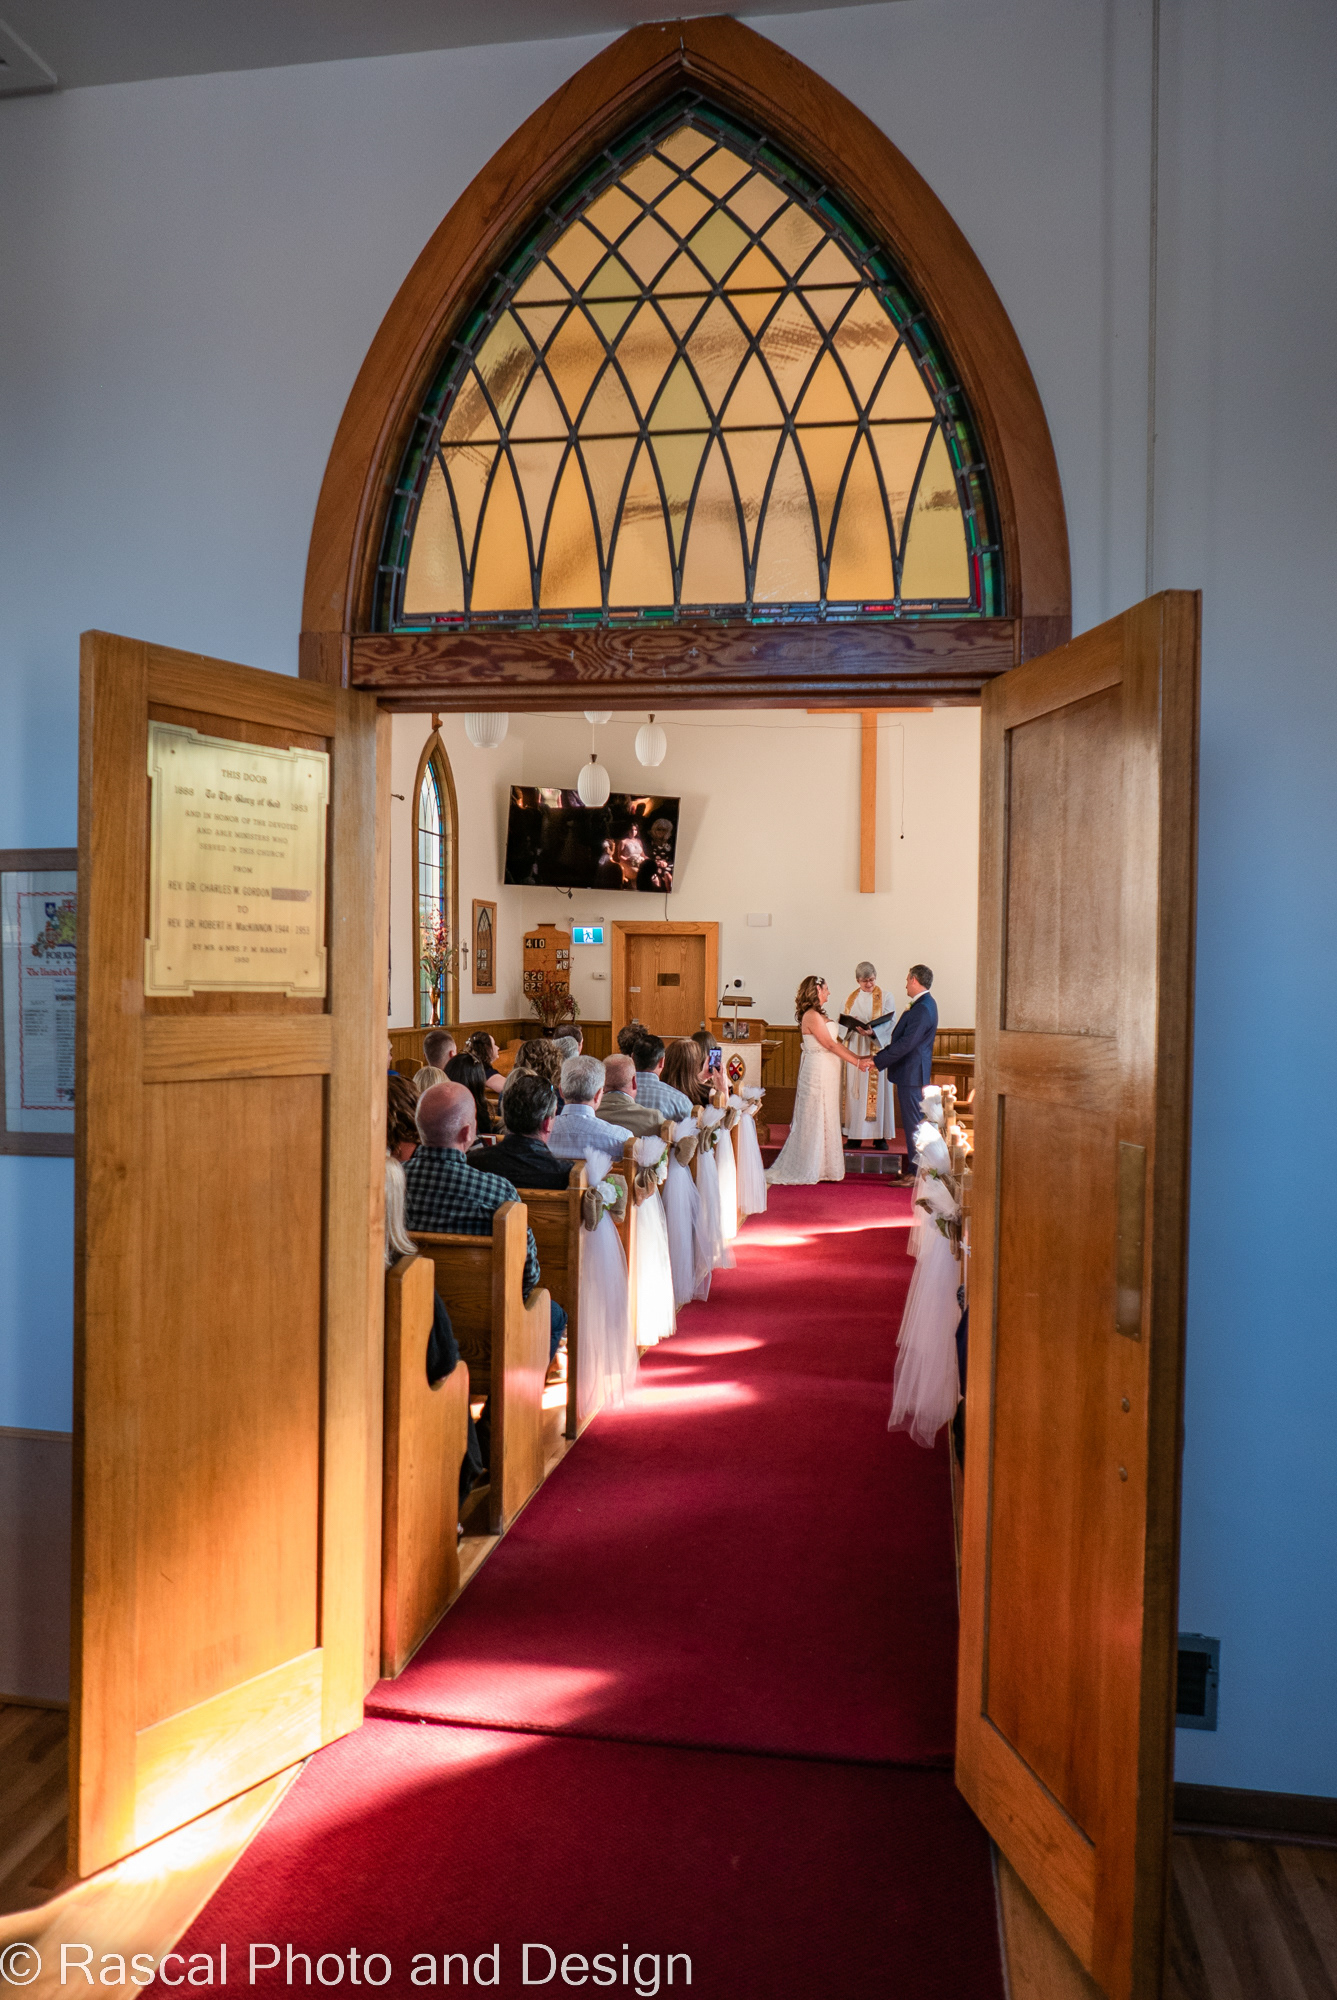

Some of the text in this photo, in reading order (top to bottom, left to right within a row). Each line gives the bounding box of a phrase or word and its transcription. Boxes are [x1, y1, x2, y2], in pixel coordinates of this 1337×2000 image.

[221, 768, 268, 784] THIS DOOR
[205, 788, 216, 799] To
[218, 790, 232, 802] The
[234, 794, 255, 807] Glory
[257, 798, 265, 806] of
[267, 799, 281, 809] God
[185, 810, 201, 818] AND
[214, 813, 239, 823] HONOR
[253, 818, 266, 827] THE
[268, 820, 298, 831] DEVOTED
[197, 827, 212, 835] AND
[256, 849, 285, 858] CHURCH
[233, 865, 253, 874] FROM
[200, 882, 232, 895] CHARLES
[242, 886, 270, 897] GORDON
[237, 905, 249, 914] TO
[198, 920, 225, 930] ROBERT
[526, 938, 546, 948] 410
[524, 972, 544, 980] 626
